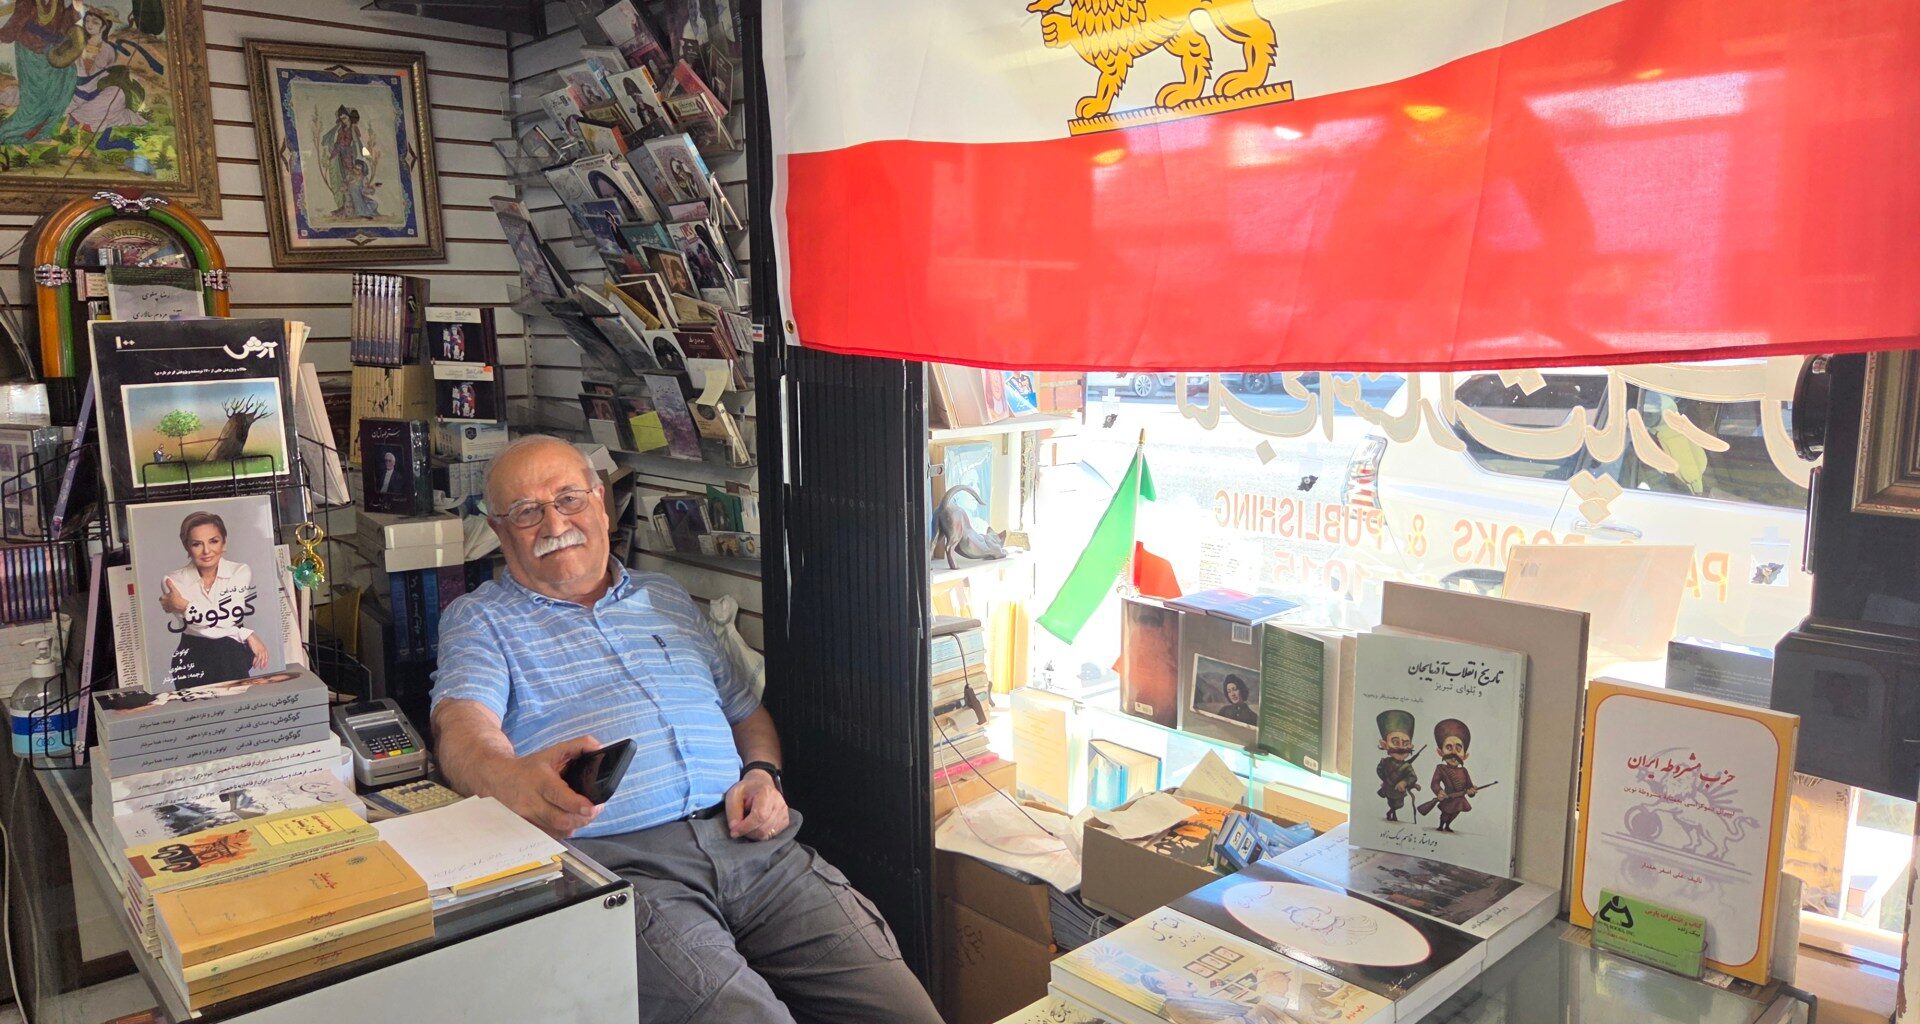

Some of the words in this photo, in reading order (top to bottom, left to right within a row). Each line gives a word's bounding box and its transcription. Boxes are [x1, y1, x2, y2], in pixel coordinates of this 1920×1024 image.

[223, 335, 279, 360] آرش
[167, 592, 258, 633] گوگوش
[1408, 661, 1450, 681] آذربایجان
[1445, 661, 1477, 682] انقلاب
[1478, 662, 1504, 686] تاریخ
[1627, 755, 1660, 779] ایران
[1660, 752, 1702, 779] مشروطه
[1700, 769, 1736, 789] حزب
